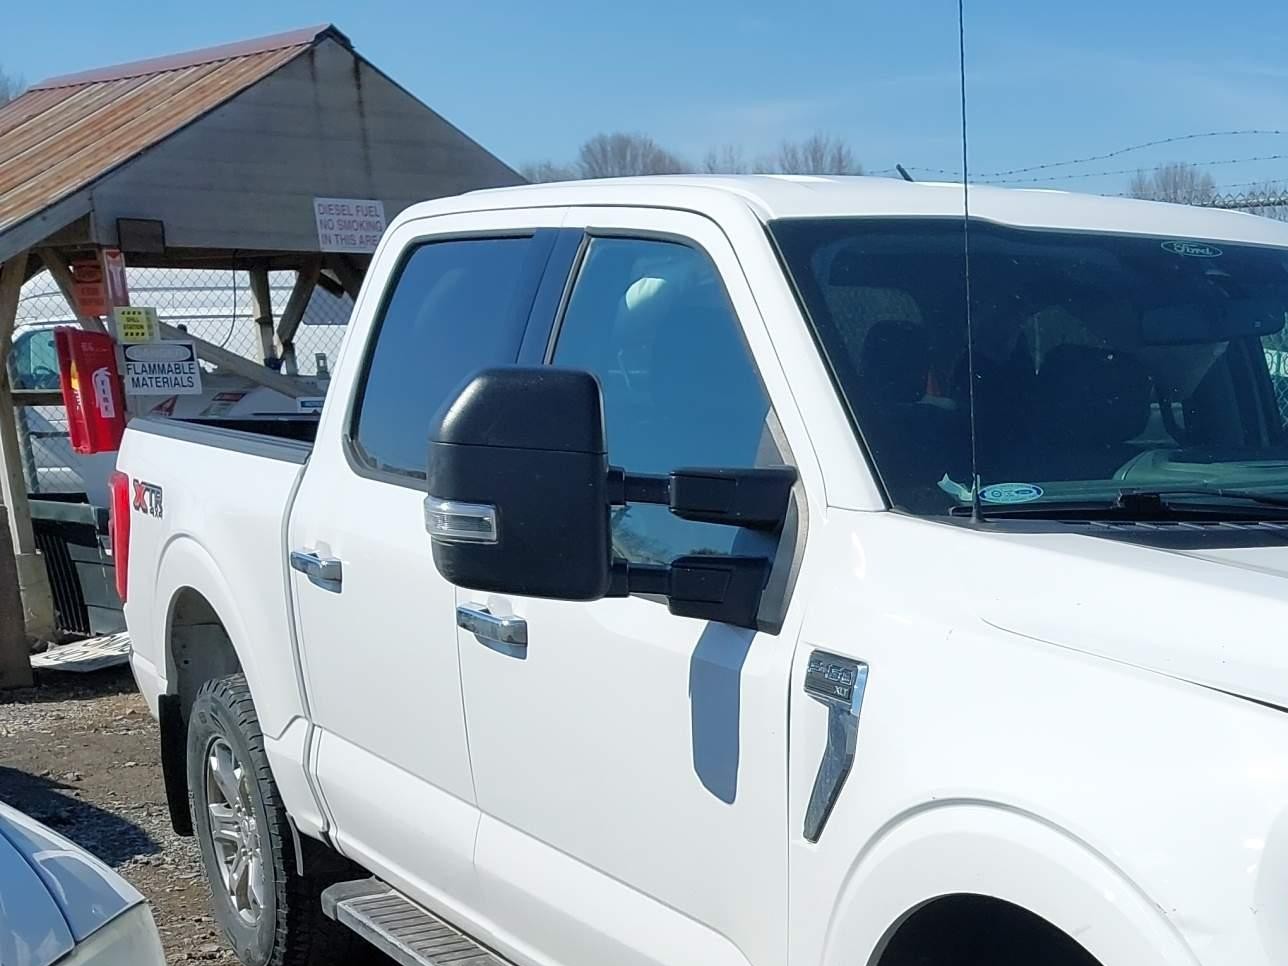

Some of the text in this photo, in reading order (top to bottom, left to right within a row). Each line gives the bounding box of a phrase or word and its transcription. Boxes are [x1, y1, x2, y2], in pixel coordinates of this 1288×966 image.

[317, 203, 381, 218] DIESEL FUEL
[319, 218, 383, 233] NO SMOKING
[320, 232, 333, 245] IN
[333, 233, 357, 246] THIS
[126, 362, 196, 375] FLAMMABLE
[131, 376, 194, 389] MATERIALS
[833, 685, 849, 698] XLT
